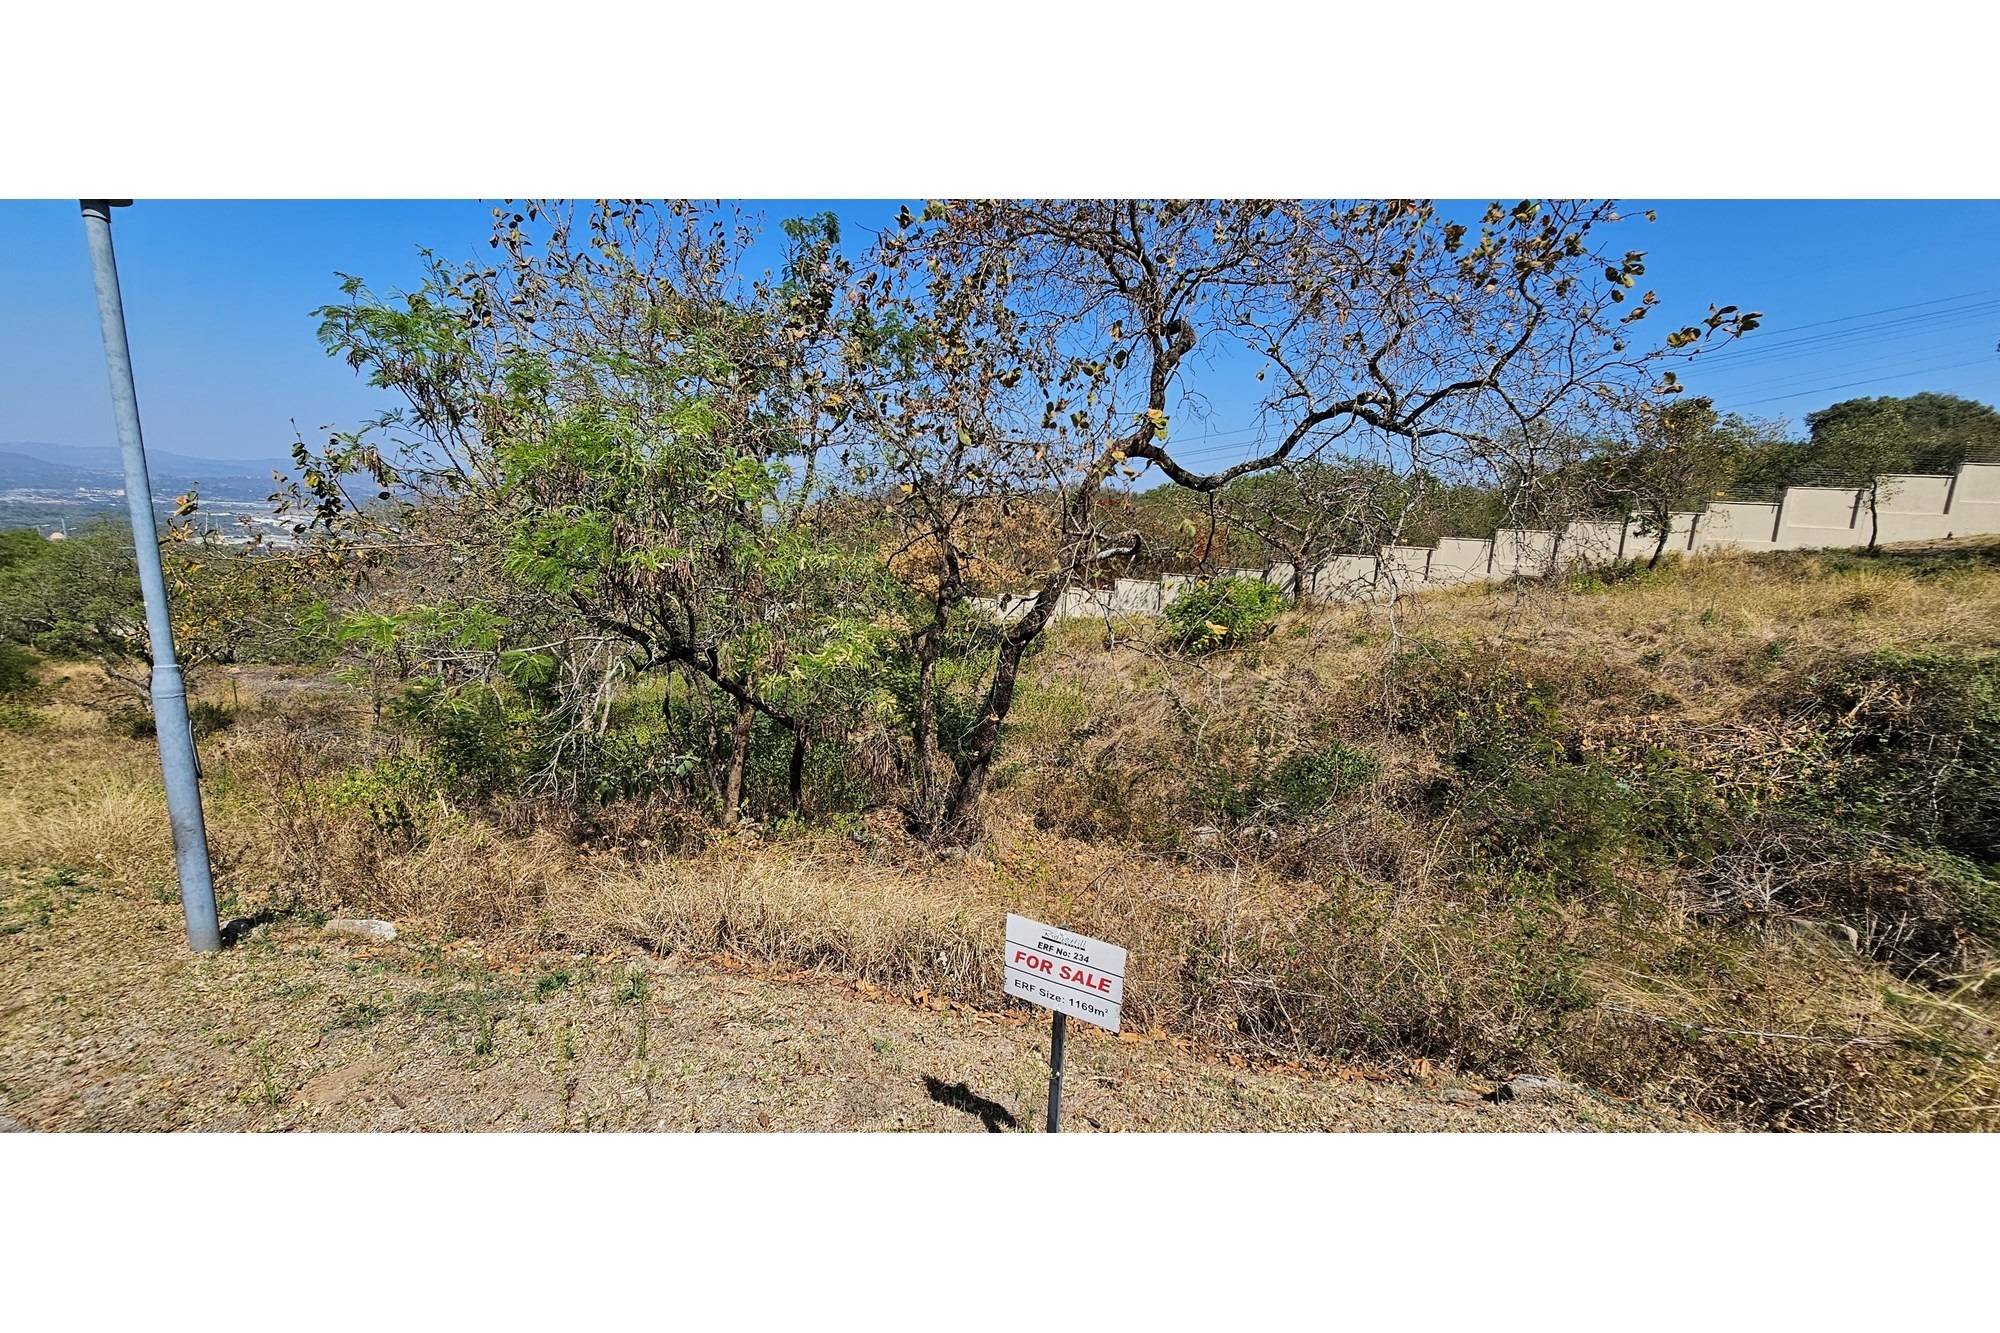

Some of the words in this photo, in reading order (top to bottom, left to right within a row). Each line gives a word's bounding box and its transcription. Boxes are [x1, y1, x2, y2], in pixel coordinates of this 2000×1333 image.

[1037, 941, 1054, 952] ERF
[1055, 947, 1071, 958] No:
[1073, 952, 1090, 963] 234
[1014, 950, 1053, 975] FOR
[1059, 965, 1112, 994] SALE
[1014, 979, 1036, 993] ERF
[1039, 988, 1065, 1004] Size:
